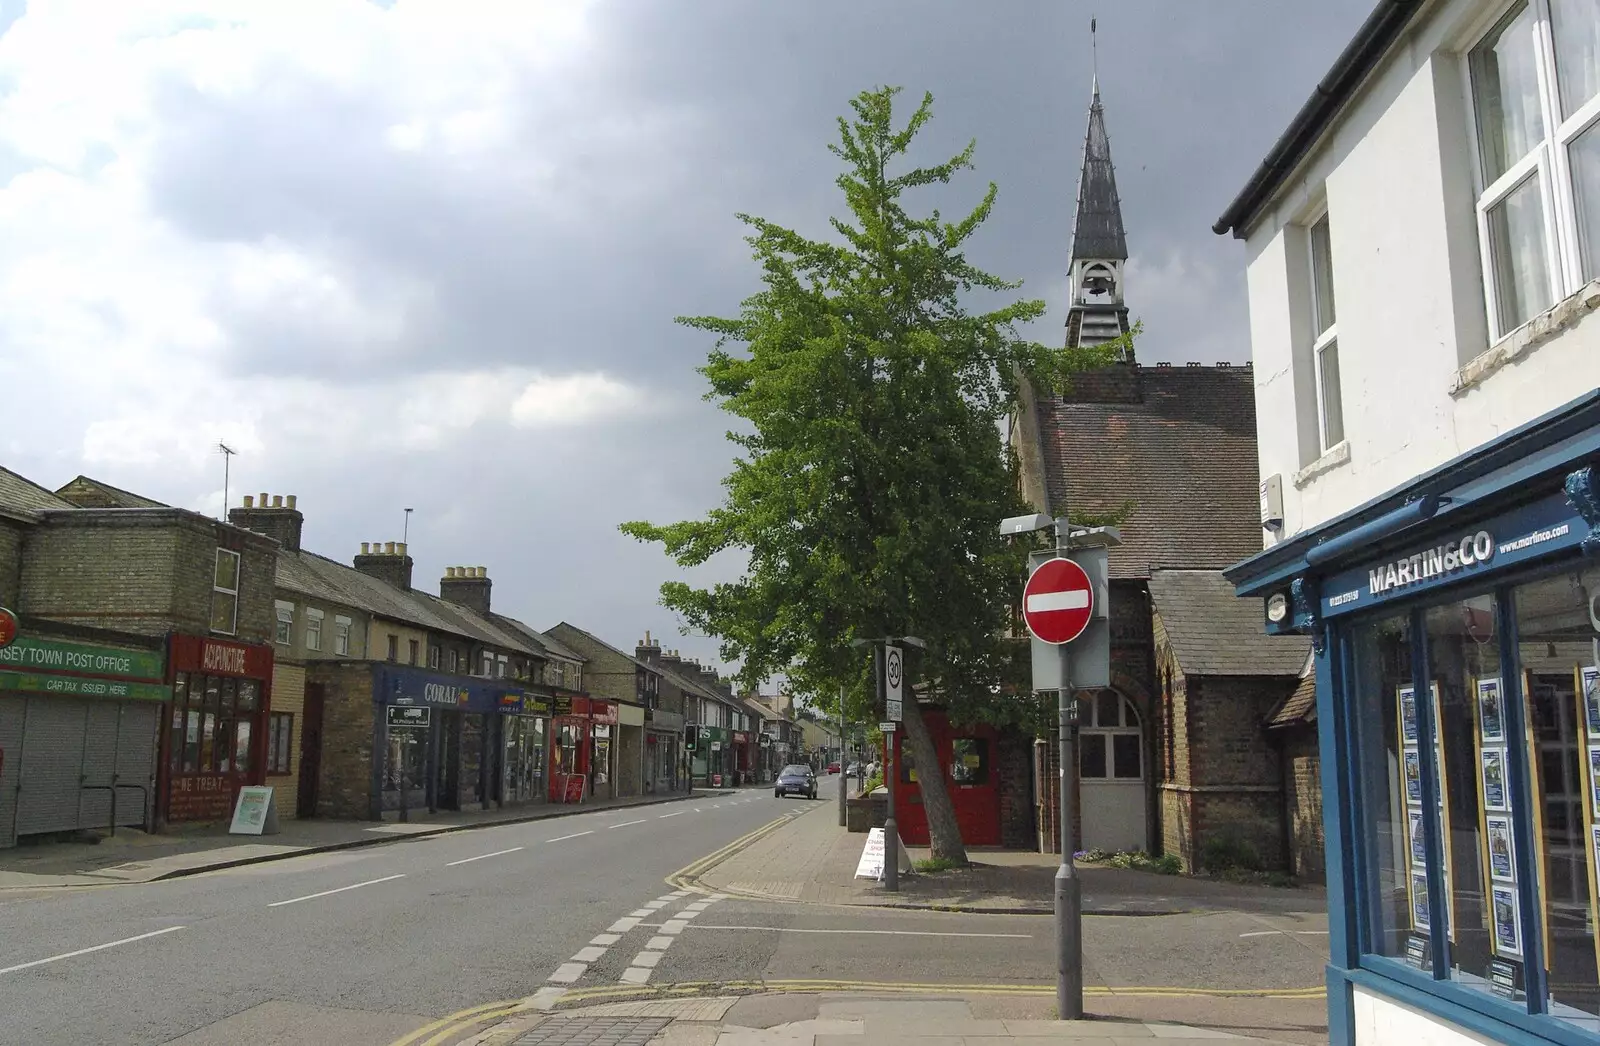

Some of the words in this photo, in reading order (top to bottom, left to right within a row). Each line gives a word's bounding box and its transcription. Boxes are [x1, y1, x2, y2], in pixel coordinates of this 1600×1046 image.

[1500, 525, 1568, 554] www.martinco.com
[1369, 531, 1493, 594] MARTIN&CO
[29, 648, 63, 665] TOWN
[66, 652, 94, 668] POST
[96, 656, 130, 672] OFFICE
[889, 661, 898, 679] 30
[47, 680, 62, 690] CAR
[64, 682, 77, 692] TAX
[82, 683, 106, 694] ISSUED
[109, 685, 127, 695] HERE
[424, 683, 457, 704] CORAL
[196, 777, 224, 792] TREAT
